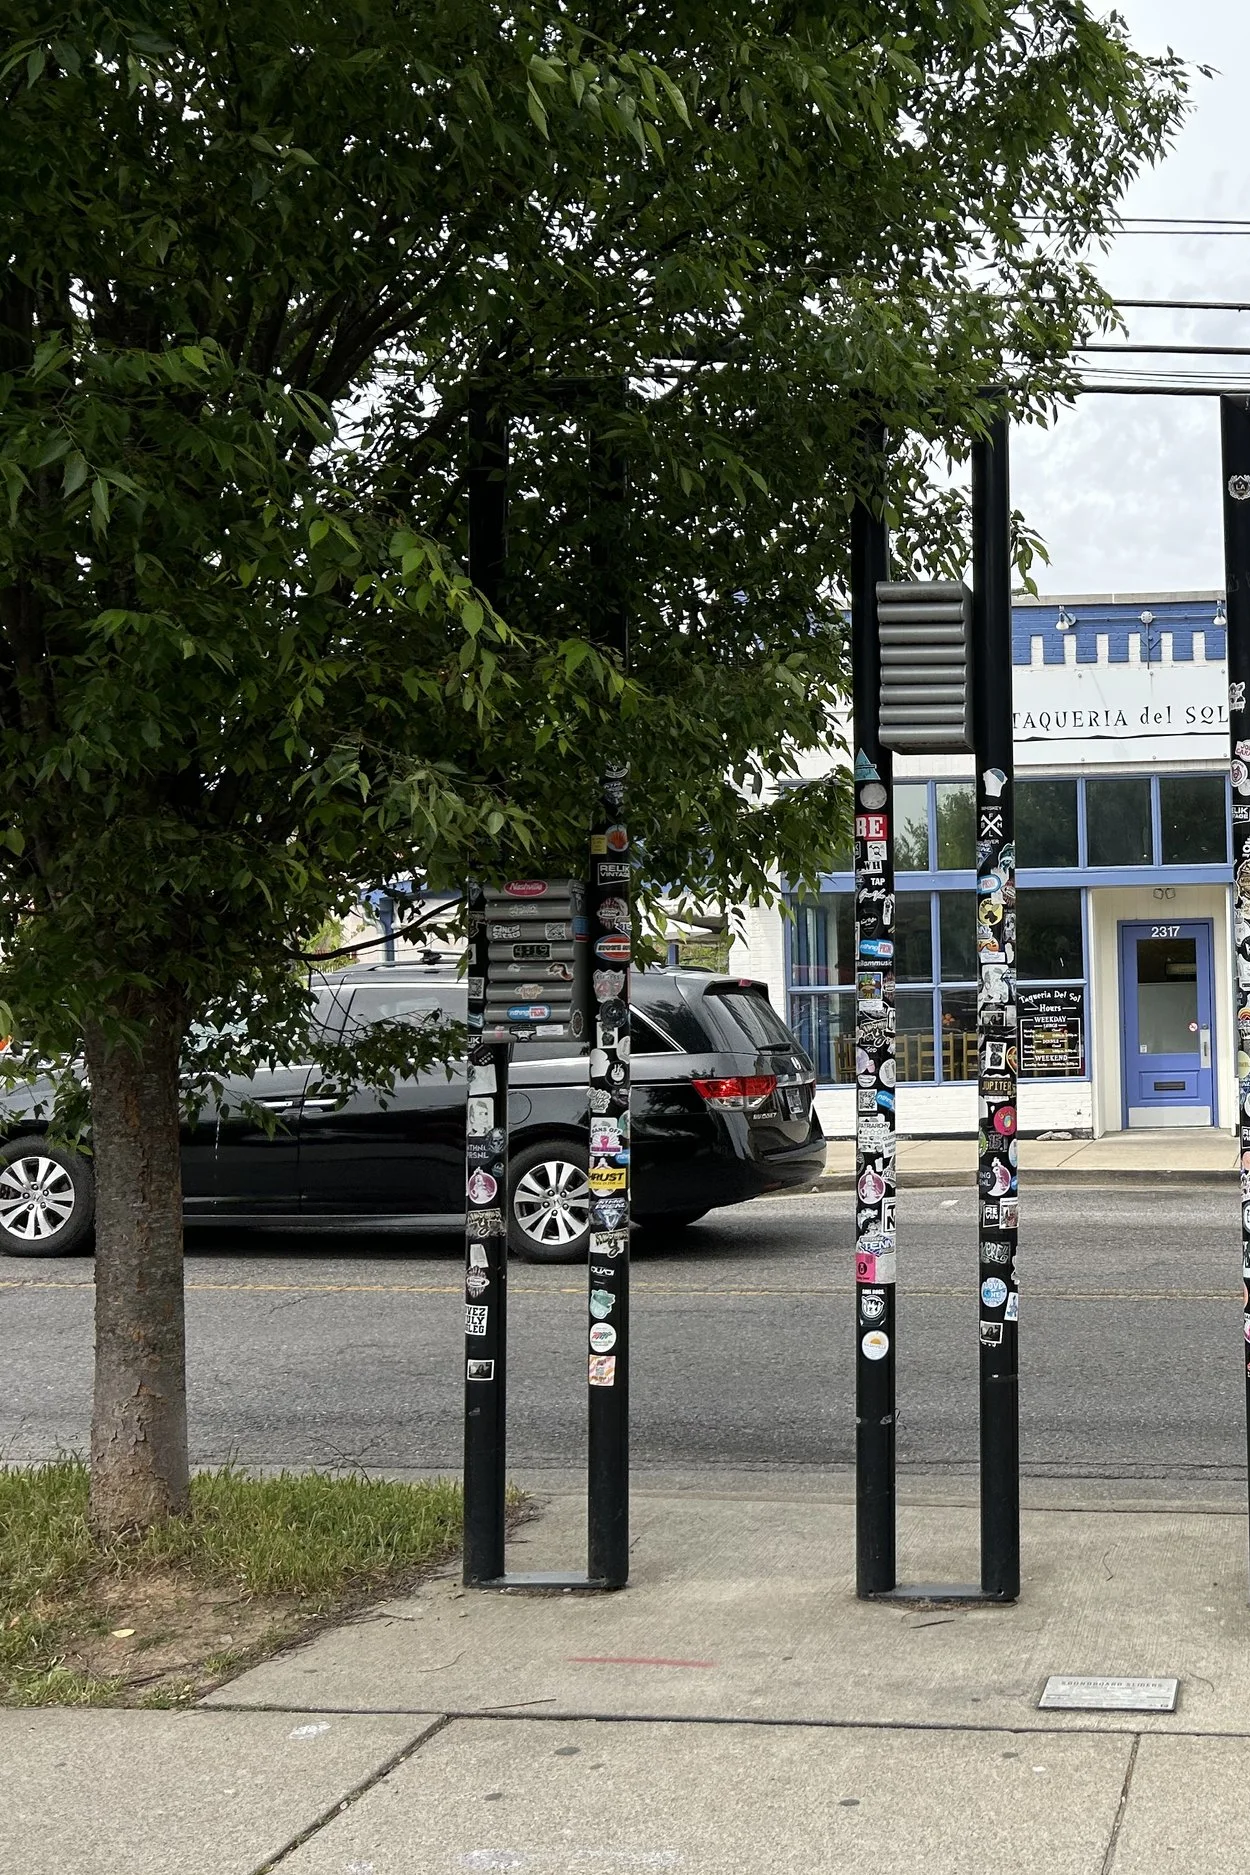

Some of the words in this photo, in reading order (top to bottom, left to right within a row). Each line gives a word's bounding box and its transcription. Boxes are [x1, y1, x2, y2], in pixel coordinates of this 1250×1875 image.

[1012, 709, 1128, 731] TAQUERIA
[1140, 705, 1172, 725] del
[1185, 705, 1229, 724] SOL
[857, 816, 884, 838] BE
[509, 881, 543, 891] Nashville
[871, 877, 886, 886] TAP
[1151, 926, 1181, 938] 2317
[1018, 990, 1052, 1004] Taqueria
[1054, 990, 1067, 999] Del
[1069, 992, 1082, 1003] Sol
[1039, 1003, 1062, 1012] Hours
[1034, 1015, 1067, 1023] WEEKDAY
[1034, 1054, 1068, 1062] WEEKEND
[981, 1081, 1013, 1092] JUPITER
[609, 1126, 622, 1135] OFF
[859, 1123, 890, 1131] PATRIARCHY
[588, 1172, 625, 1182] HRUST
